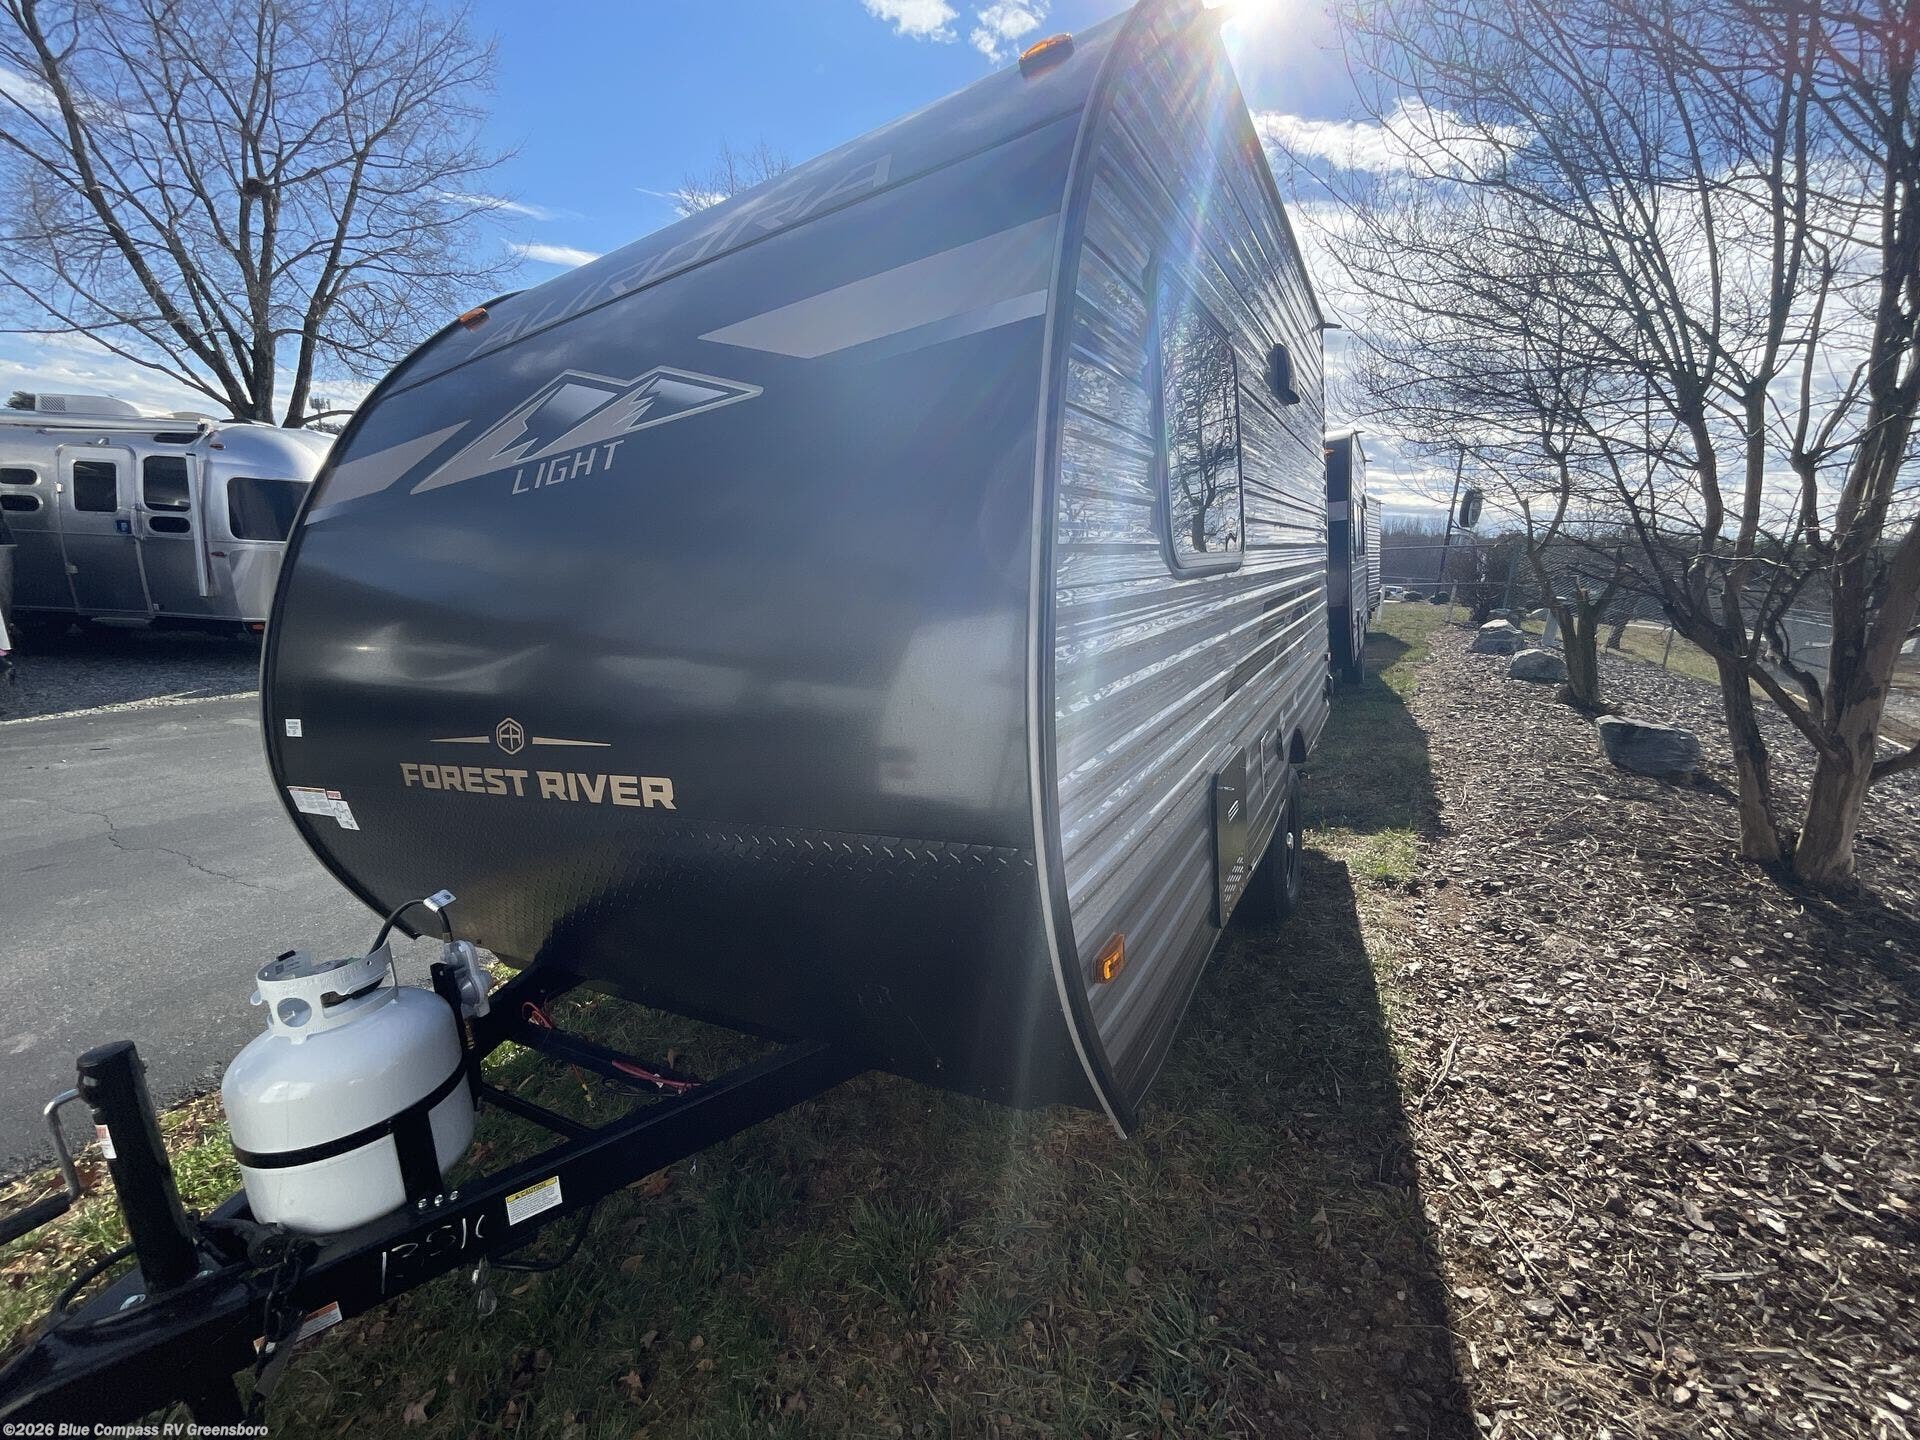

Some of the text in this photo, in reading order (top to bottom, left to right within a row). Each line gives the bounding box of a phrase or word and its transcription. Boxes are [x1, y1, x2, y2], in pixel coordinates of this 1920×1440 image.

[466, 153, 893, 359] AURORA
[512, 440, 624, 495] LIGHT
[400, 762, 677, 810] FOREST RIVER
